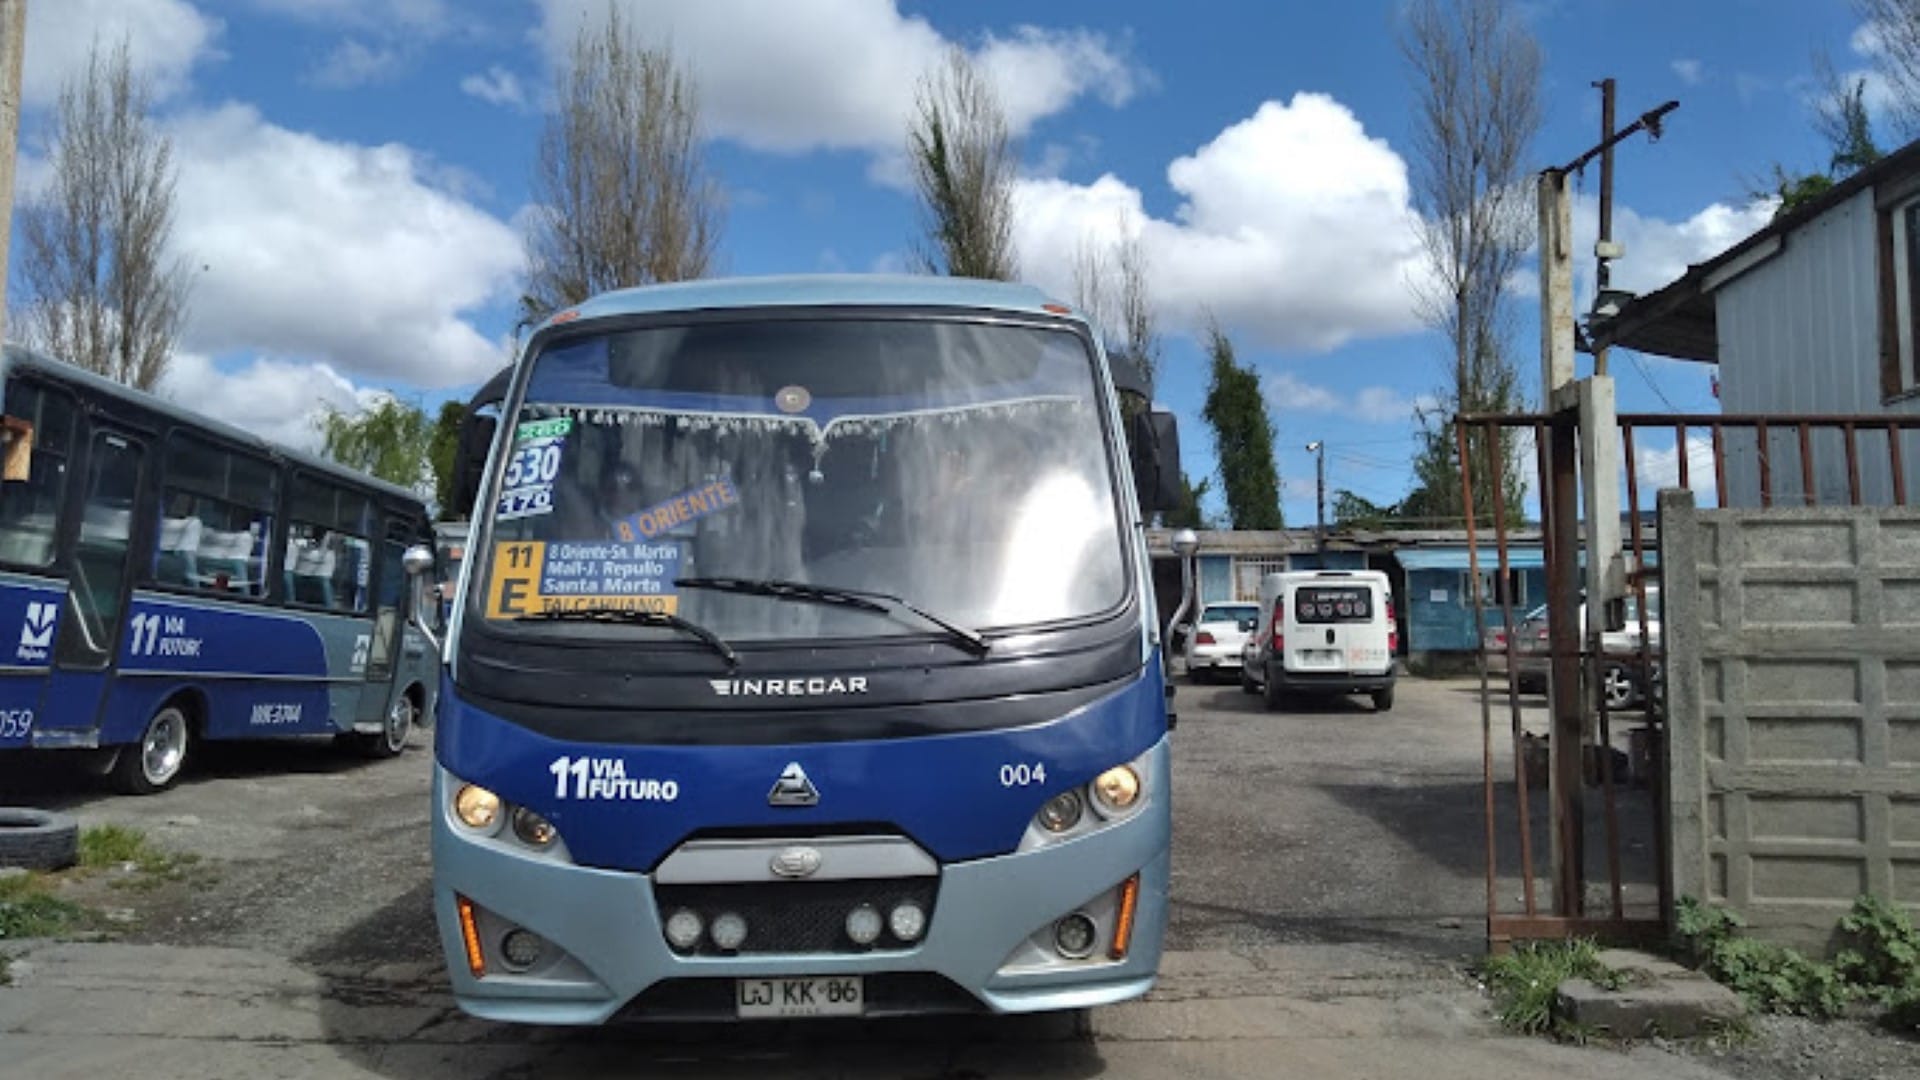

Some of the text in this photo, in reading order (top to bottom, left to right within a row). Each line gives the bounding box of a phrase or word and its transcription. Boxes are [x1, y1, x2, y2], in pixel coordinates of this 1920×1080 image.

[505, 446, 560, 487] 530
[618, 481, 734, 542] 8 ORIENTE
[507, 545, 532, 568] 11
[603, 561, 663, 579] Repullo
[501, 578, 530, 613] E
[543, 578, 661, 593] Santa Marta
[131, 612, 160, 656] 11
[732, 676, 868, 695] INRECAR
[549, 756, 626, 800] 11 VIA
[1000, 761, 1047, 787] 004
[588, 779, 678, 801] FUTURO
[783, 981, 815, 1006] KK
